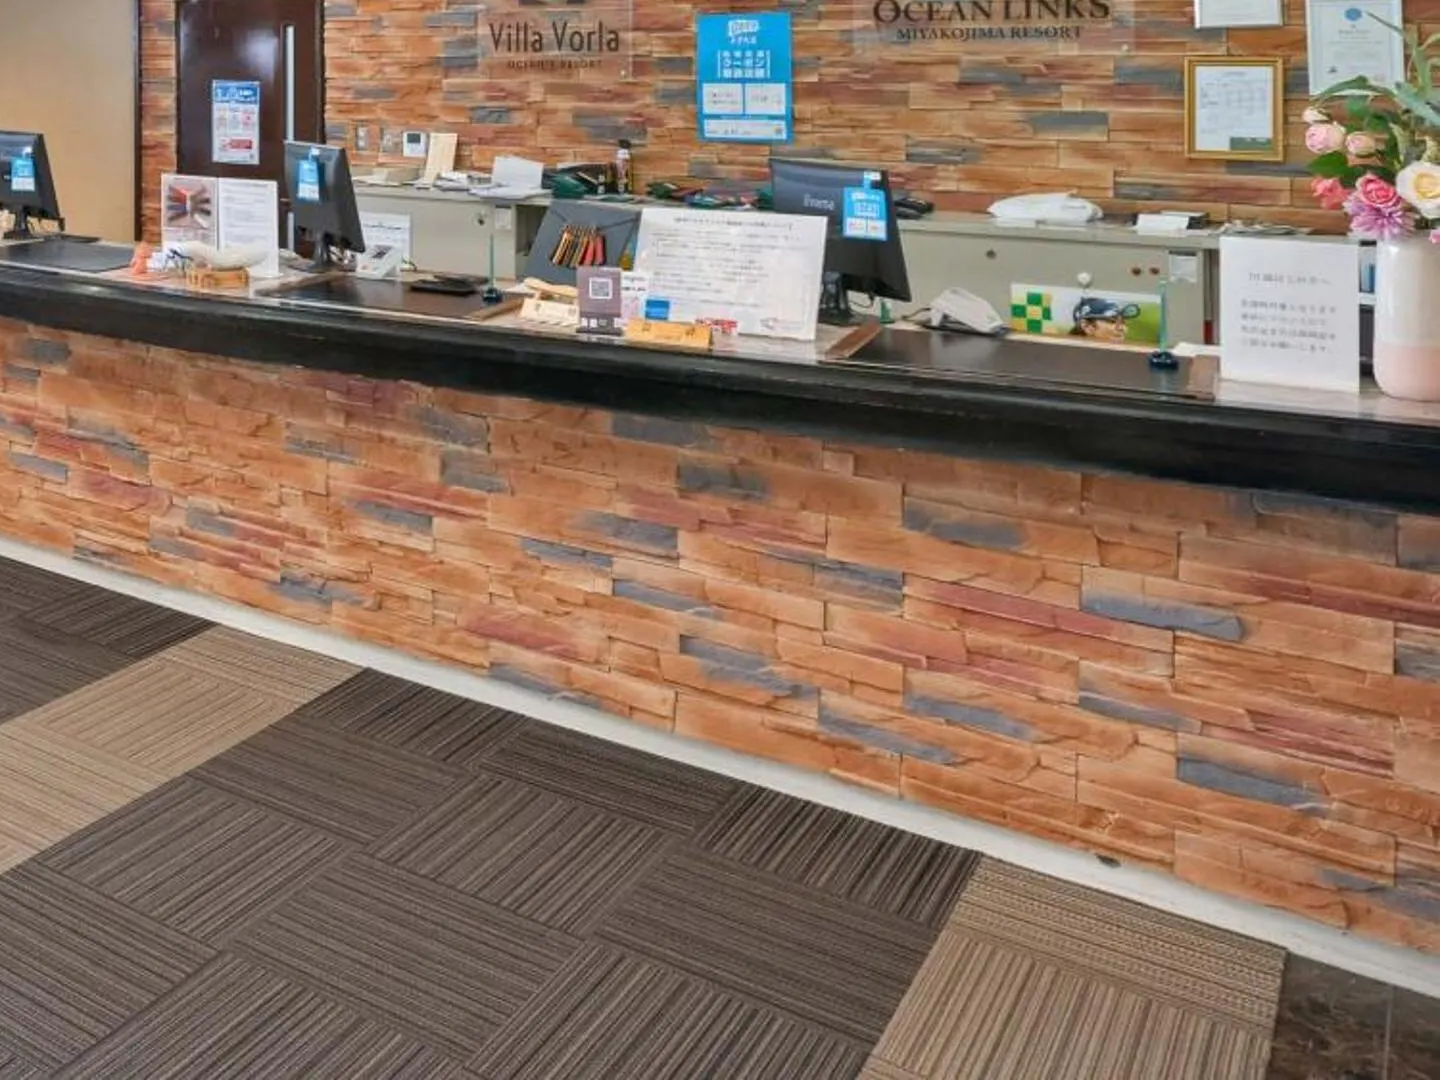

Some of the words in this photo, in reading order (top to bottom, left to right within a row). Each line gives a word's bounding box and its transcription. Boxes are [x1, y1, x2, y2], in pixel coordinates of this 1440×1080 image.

[488, 21, 543, 52] Villa
[552, 21, 620, 52] Vorla
[896, 26, 1006, 42] MIYAKOJIMA
[1010, 25, 1084, 39] RESORT
